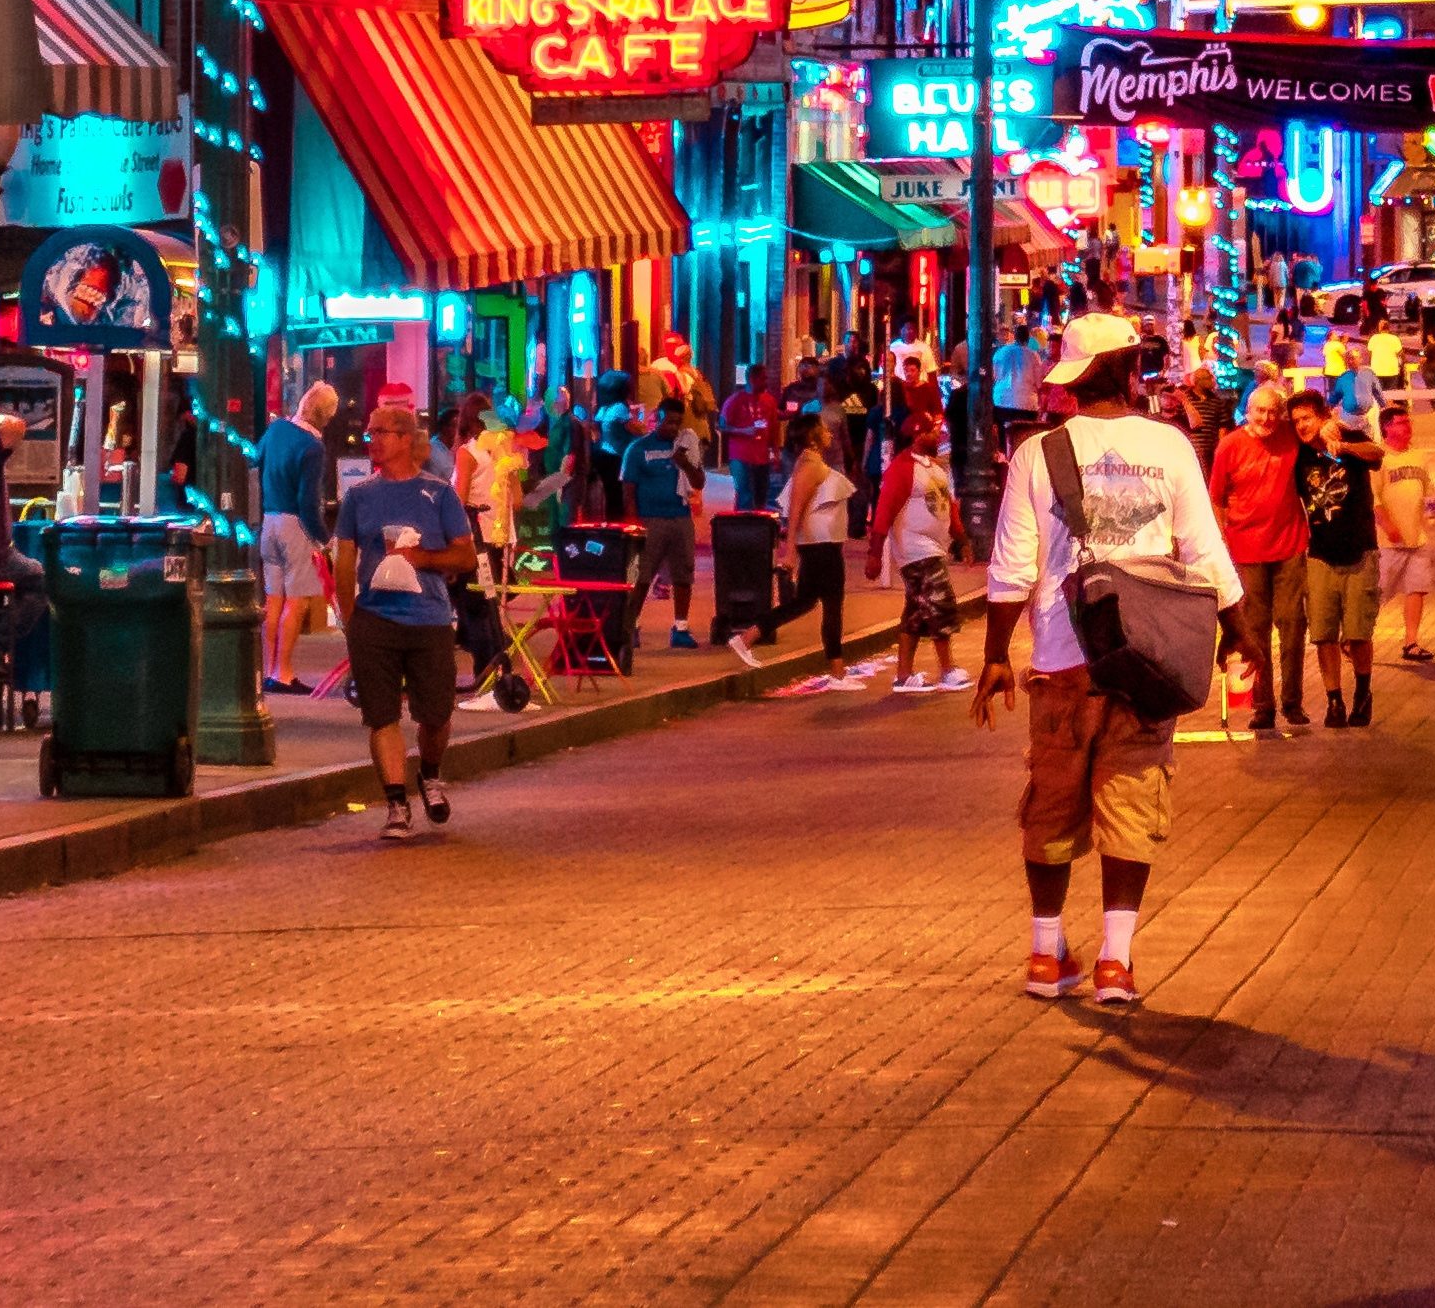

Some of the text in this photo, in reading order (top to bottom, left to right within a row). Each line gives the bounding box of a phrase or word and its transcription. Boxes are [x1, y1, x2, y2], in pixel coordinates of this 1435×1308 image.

[534, 32, 703, 77] CAFE
[1079, 55, 1237, 122] Memphis
[1246, 78, 1412, 103] WELCOMES
[907, 118, 1023, 153] HAL
[891, 180, 943, 199] JUKE
[957, 178, 1017, 197] JNT
[316, 324, 379, 344] ATM
